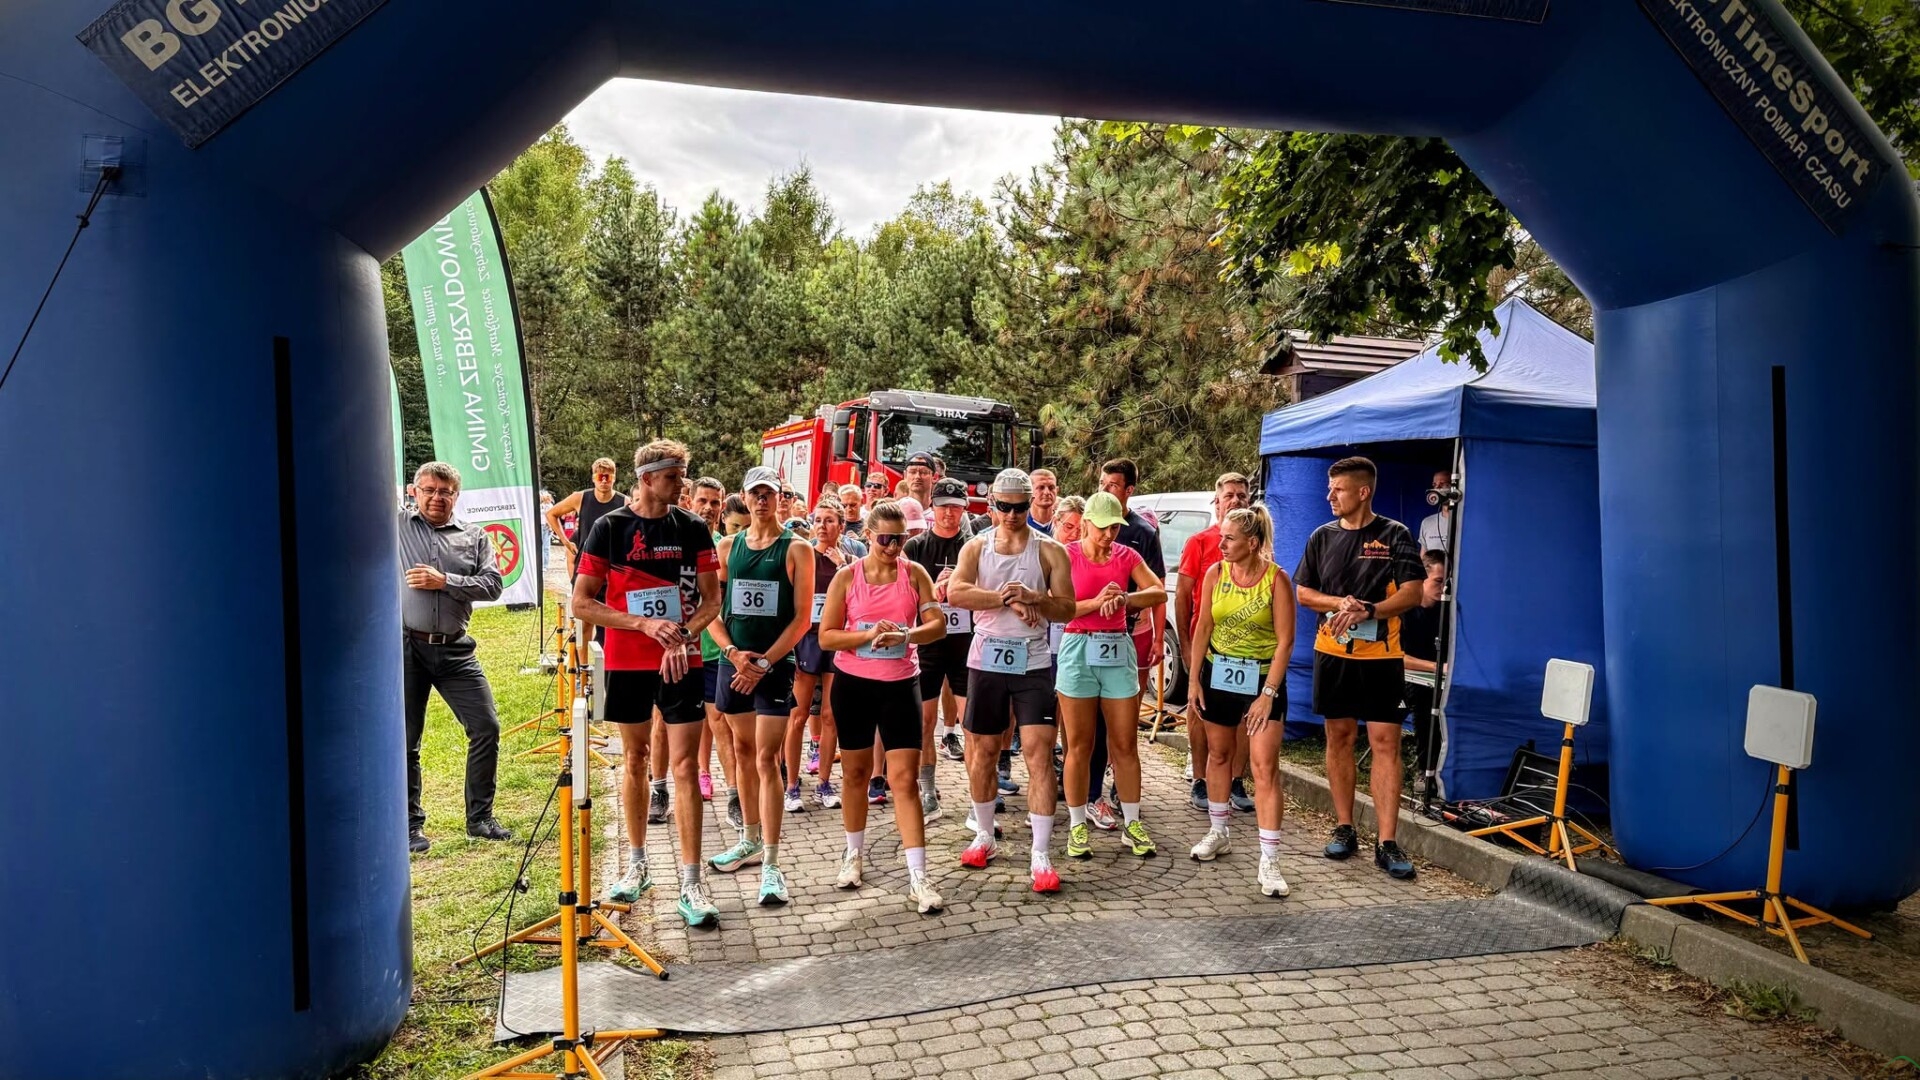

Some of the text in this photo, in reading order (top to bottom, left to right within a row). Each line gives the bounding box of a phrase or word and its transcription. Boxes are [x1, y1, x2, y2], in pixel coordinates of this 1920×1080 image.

[120, 0, 247, 72] BG
[170, 0, 328, 109] ELEKTRONIC
[1706, 0, 1870, 186] TimeSport
[1755, 97, 1808, 159] POMIAR
[1805, 157, 1851, 209] CZASU
[626, 551, 682, 560] reklama
[643, 599, 667, 618] 59
[742, 591, 764, 608] 36
[993, 648, 1015, 666] 76
[1099, 643, 1118, 659] 21
[1223, 667, 1245, 685] 20
